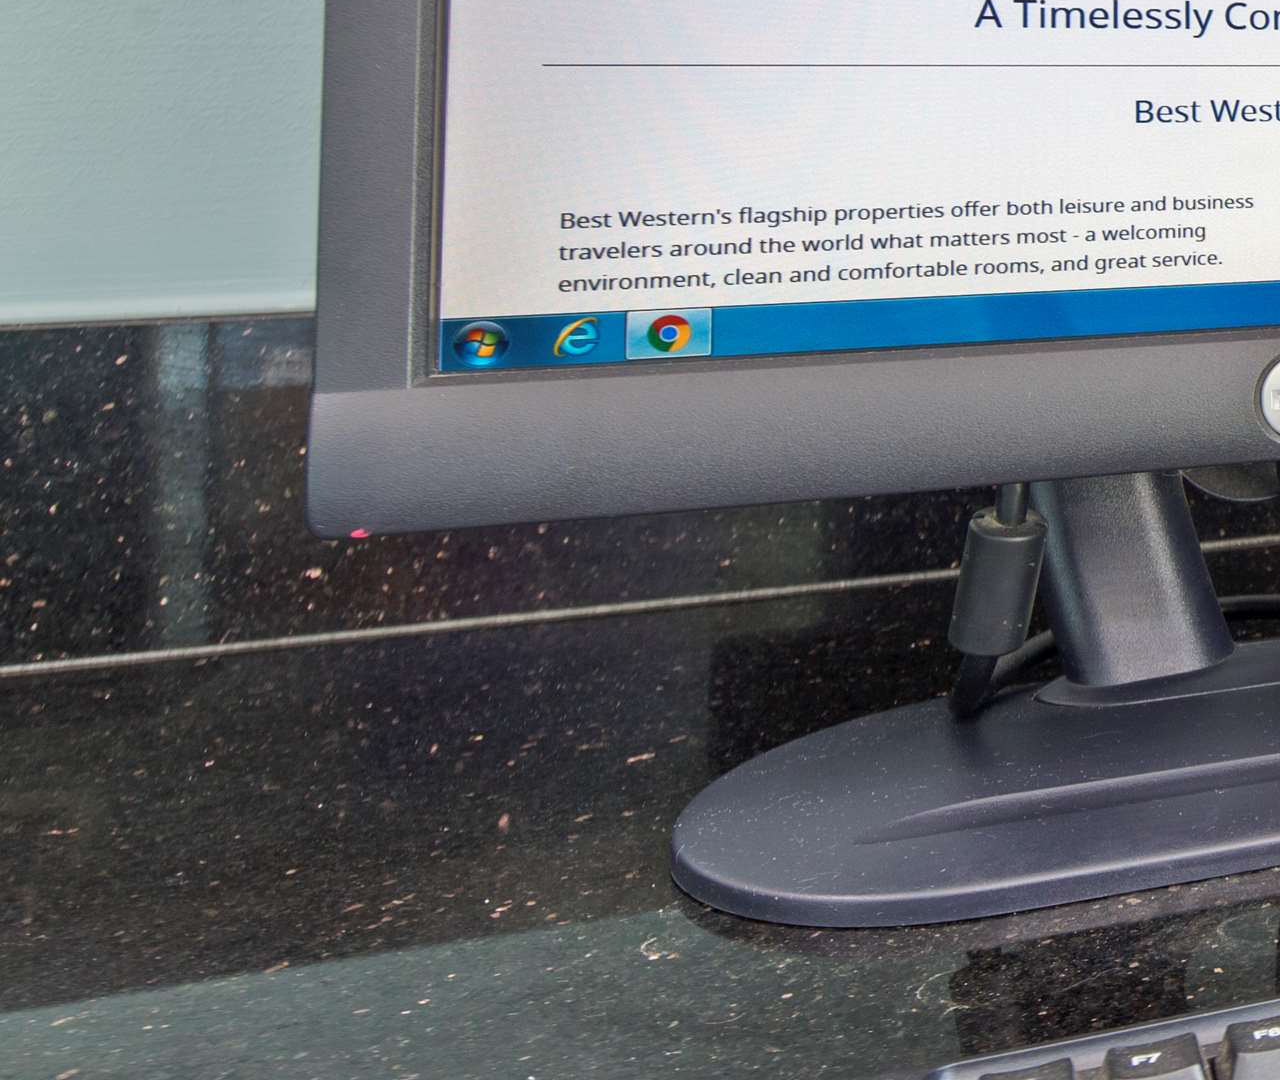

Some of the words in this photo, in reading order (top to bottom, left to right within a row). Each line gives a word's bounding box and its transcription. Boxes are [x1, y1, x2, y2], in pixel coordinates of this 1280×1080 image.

[974, 0, 1003, 29] A
[1013, 0, 1214, 38] Timelessly
[1135, 99, 1201, 124] Best
[560, 211, 613, 230] Best
[618, 208, 732, 228] Western's
[739, 206, 827, 229] flagship
[834, 202, 945, 227] properties
[950, 200, 1001, 219] offer
[1007, 199, 1053, 216] both
[1060, 197, 1125, 215] leisure
[1131, 196, 1167, 213] and
[1172, 195, 1255, 211] business
[559, 242, 664, 261] travelers
[669, 238, 752, 258] around
[759, 237, 796, 254] the
[802, 234, 864, 253] world
[870, 233, 923, 251] what
[930, 231, 1010, 249] matters
[1016, 229, 1067, 245] most
[1084, 230, 1096, 243] a
[1102, 224, 1207, 243] welcoming
[558, 270, 716, 293] environment,
[723, 268, 783, 287] clean
[789, 265, 832, 283] and
[838, 260, 968, 281] comfortable
[974, 260, 1045, 277] rooms,
[1051, 255, 1089, 273] and
[1095, 253, 1147, 275] great
[1152, 251, 1224, 269] service.
[1131, 1051, 1163, 1067] F7
